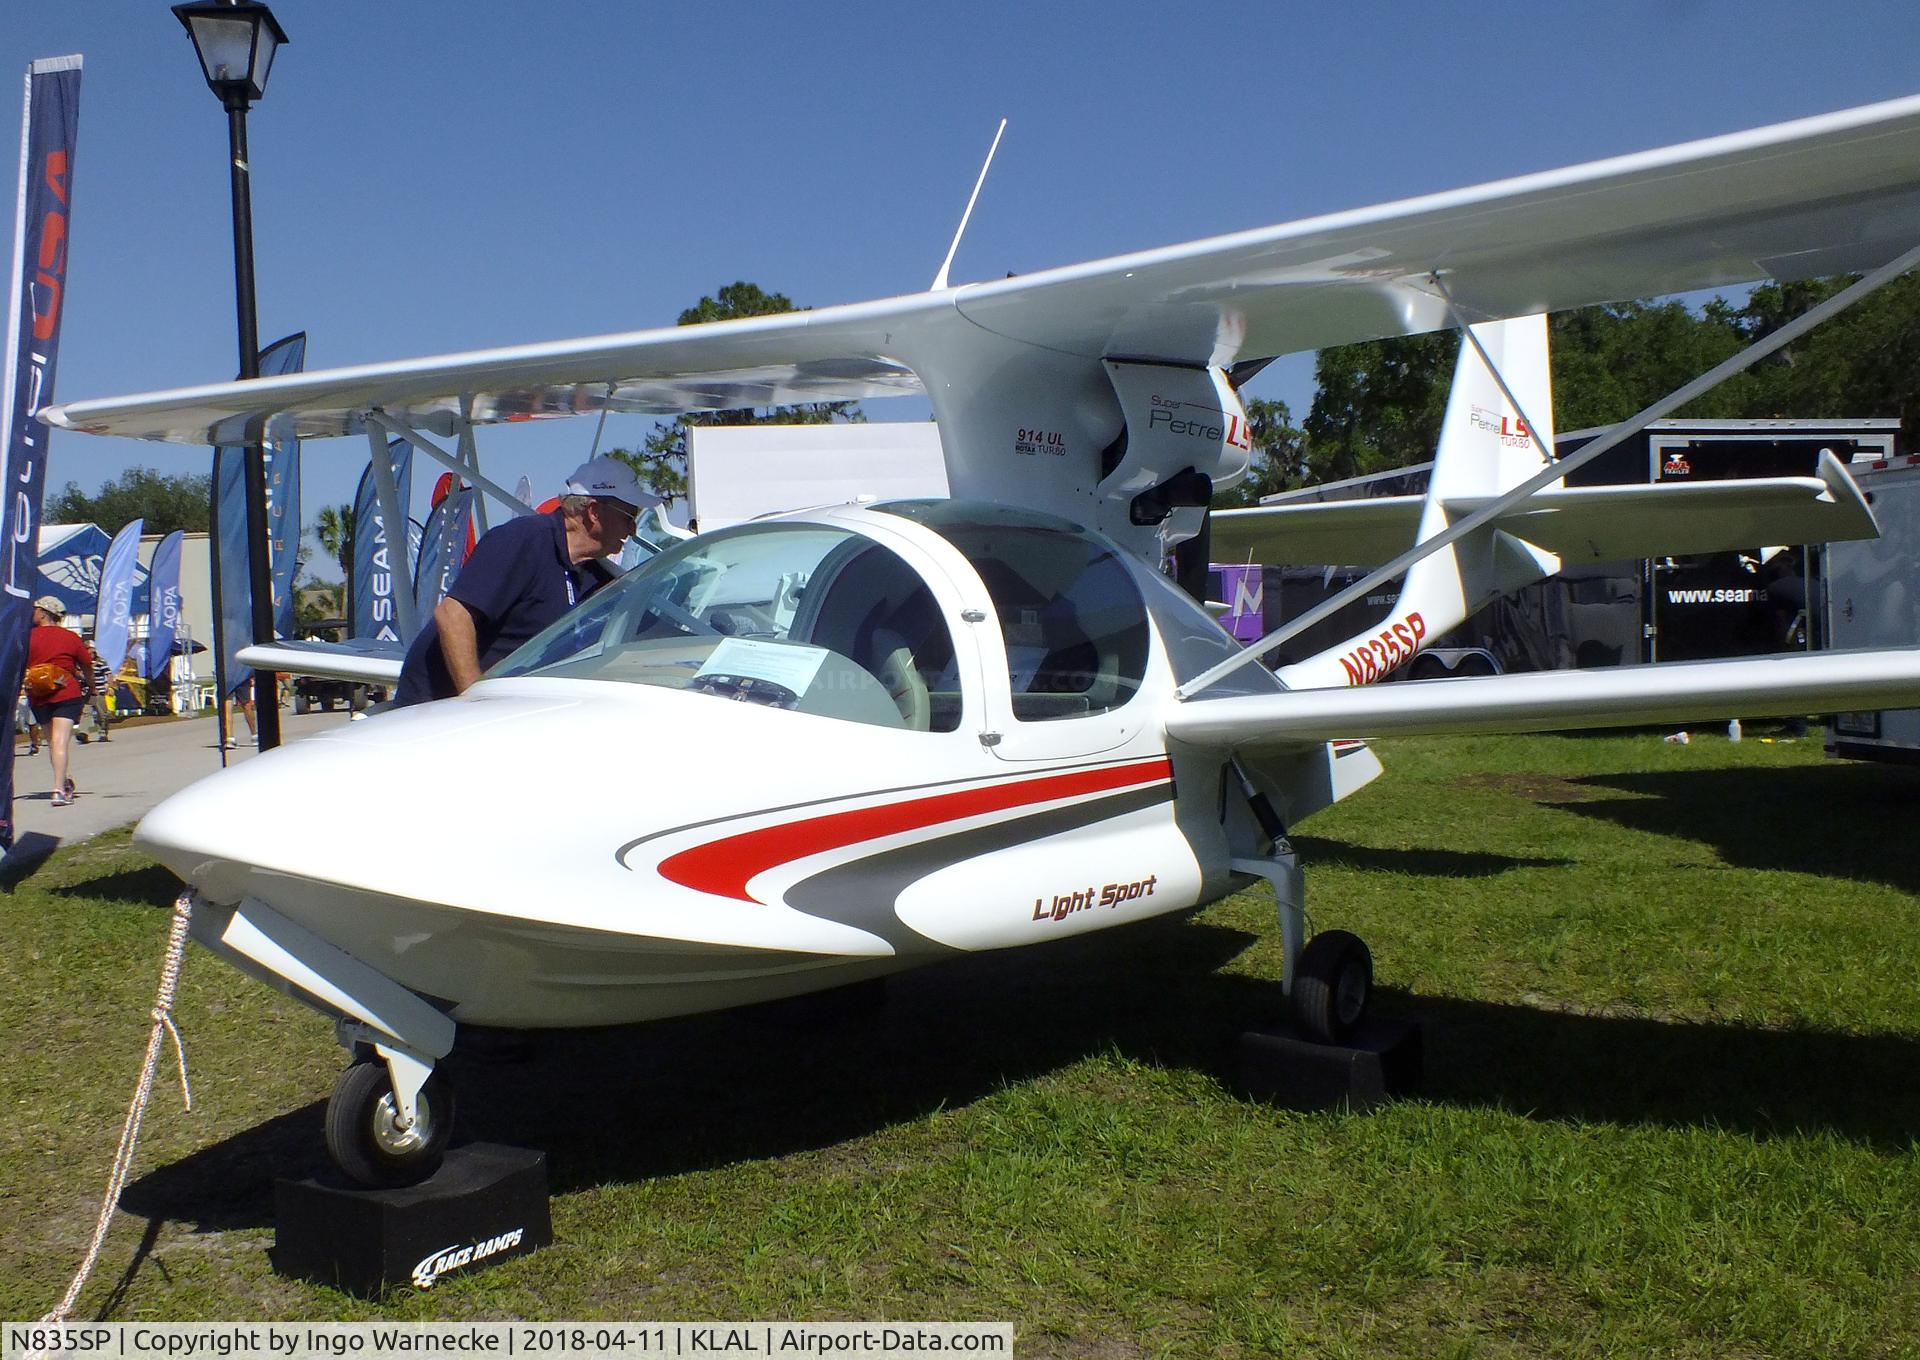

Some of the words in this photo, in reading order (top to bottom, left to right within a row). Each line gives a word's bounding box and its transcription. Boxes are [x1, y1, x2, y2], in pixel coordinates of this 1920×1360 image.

[1018, 428, 1044, 444] 914
[1048, 432, 1064, 446] UL
[1038, 444, 1066, 456] TURBO
[112, 581, 129, 627] AOPA
[163, 586, 178, 629] AOPA
[1339, 612, 1426, 687] N835SP
[1032, 887, 1096, 921] Light
[1099, 874, 1158, 909] Sport
[434, 1246, 474, 1274] RACE
[472, 1228, 524, 1261] RAMPS
